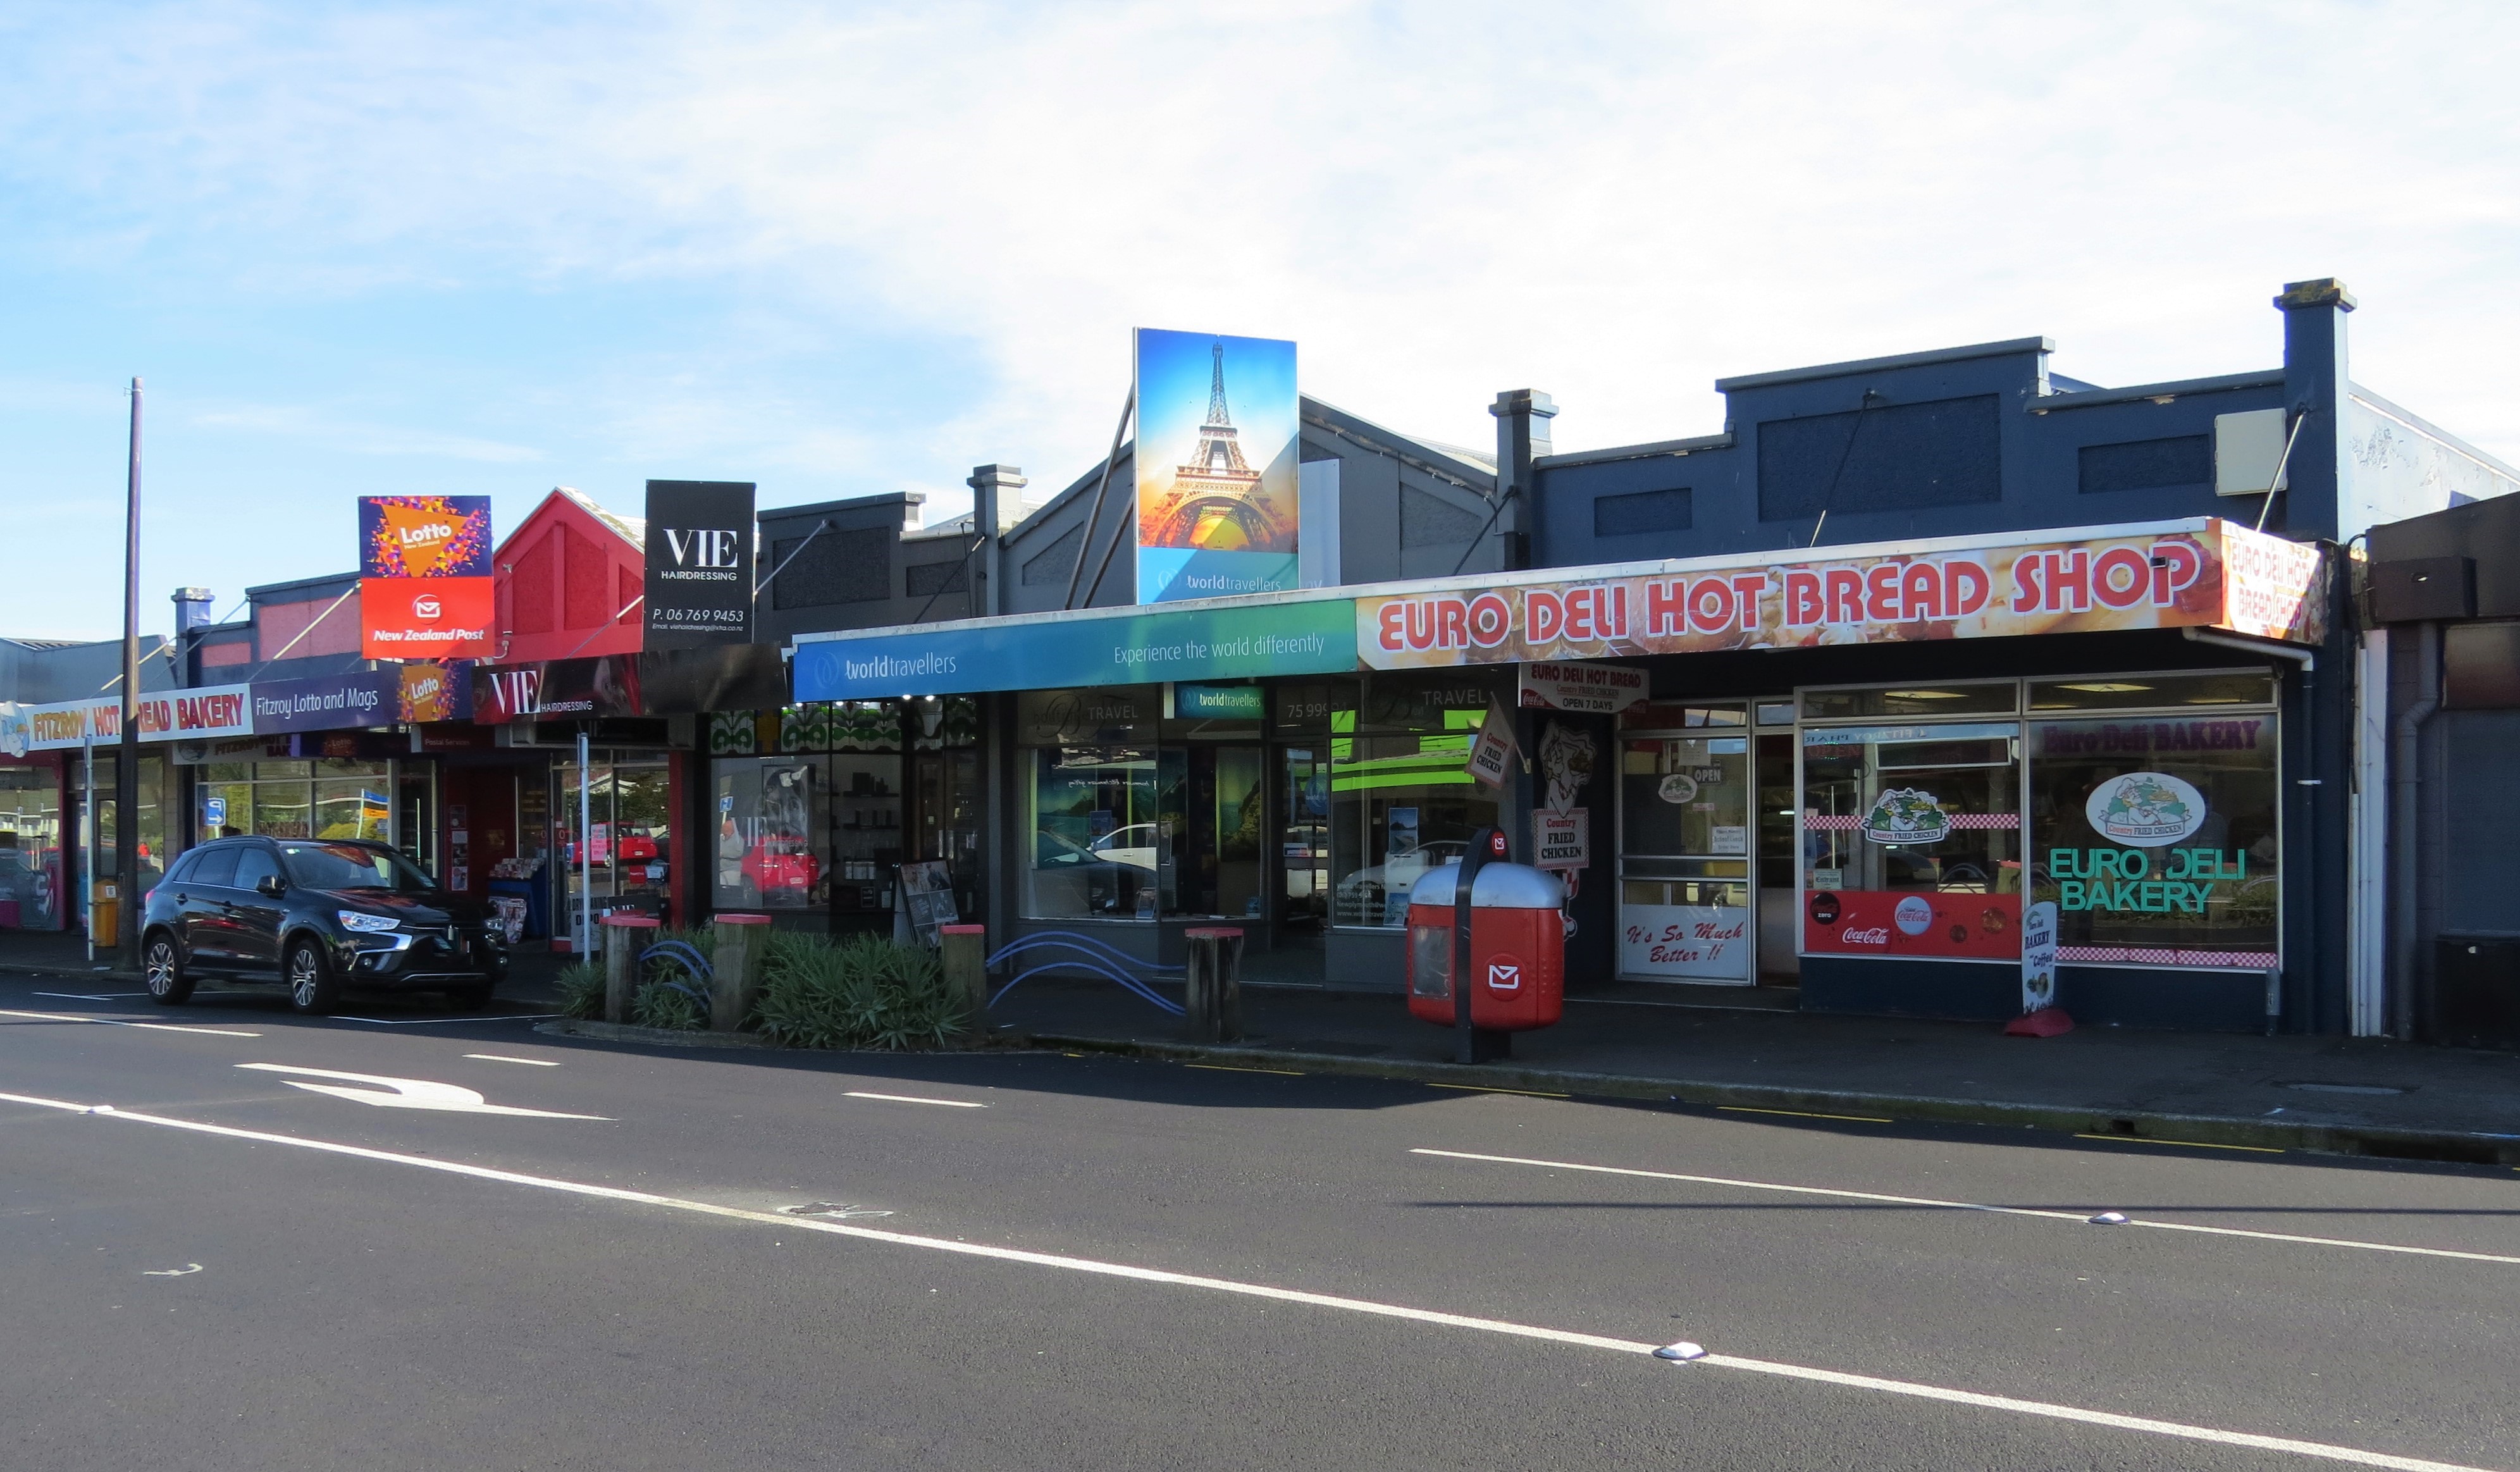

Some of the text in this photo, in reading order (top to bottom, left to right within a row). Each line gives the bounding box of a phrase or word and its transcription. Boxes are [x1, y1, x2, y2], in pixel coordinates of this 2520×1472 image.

[400, 523, 452, 544] Lotto
[417, 540, 440, 548] Zealand
[663, 529, 738, 568] VIE
[2232, 542, 2261, 576] EURO
[661, 571, 738, 581] HAIRDRESSING
[1186, 574, 1282, 591] worldtravellers
[1377, 541, 2202, 653] EURO DELI HOT BREAD SHOP
[2238, 587, 2273, 622] BREAD
[653, 609, 744, 622] P. 06 769 9453
[373, 629, 485, 641] New Zealand Post
[1115, 633, 1325, 667] Experience the world differently
[844, 652, 957, 680] worldtravellers
[1531, 664, 1641, 688] EURO DELI HOT BREAD
[411, 677, 439, 700] Lotto
[489, 671, 541, 715] VIE
[1578, 686, 1595, 695] FRIED
[1596, 687, 1619, 697] CHICKEN
[256, 687, 378, 720] Fitzroy Lotto and Mags
[541, 700, 593, 713] HAIRDRESSING
[1199, 693, 1261, 707] worldtravellers
[1421, 689, 1488, 707] TRAVEL
[1562, 698, 1614, 711] OPEN 7 DAYS
[33, 693, 244, 742] FITZROY HOT READ BAKERY
[1087, 705, 1139, 721] TRAVEL
[1287, 705, 1303, 719] 75
[1487, 733, 1509, 751] Country
[2154, 721, 2262, 751] BAKERY
[1484, 746, 1502, 762] FRIED
[1477, 754, 1503, 775] CHICKEN
[1694, 769, 1721, 782] OPEN
[1546, 819, 1576, 829] Country
[2108, 824, 2182, 836] Country FRIED CHICKEN
[1548, 832, 1575, 844] FRIED
[1872, 831, 1893, 840] Country
[1913, 831, 1938, 839] CHICKEN
[1541, 846, 1582, 860] CHICKEN
[2049, 848, 2245, 880] EURO DELI
[2061, 881, 2214, 913] BAKERY
[1897, 910, 1930, 922] Coca-Cola
[1626, 921, 1745, 944] It's So Much
[1843, 927, 1889, 944] Coca-Cola
[2024, 930, 2051, 950] BAKERY
[1650, 944, 1724, 963] Better !!
